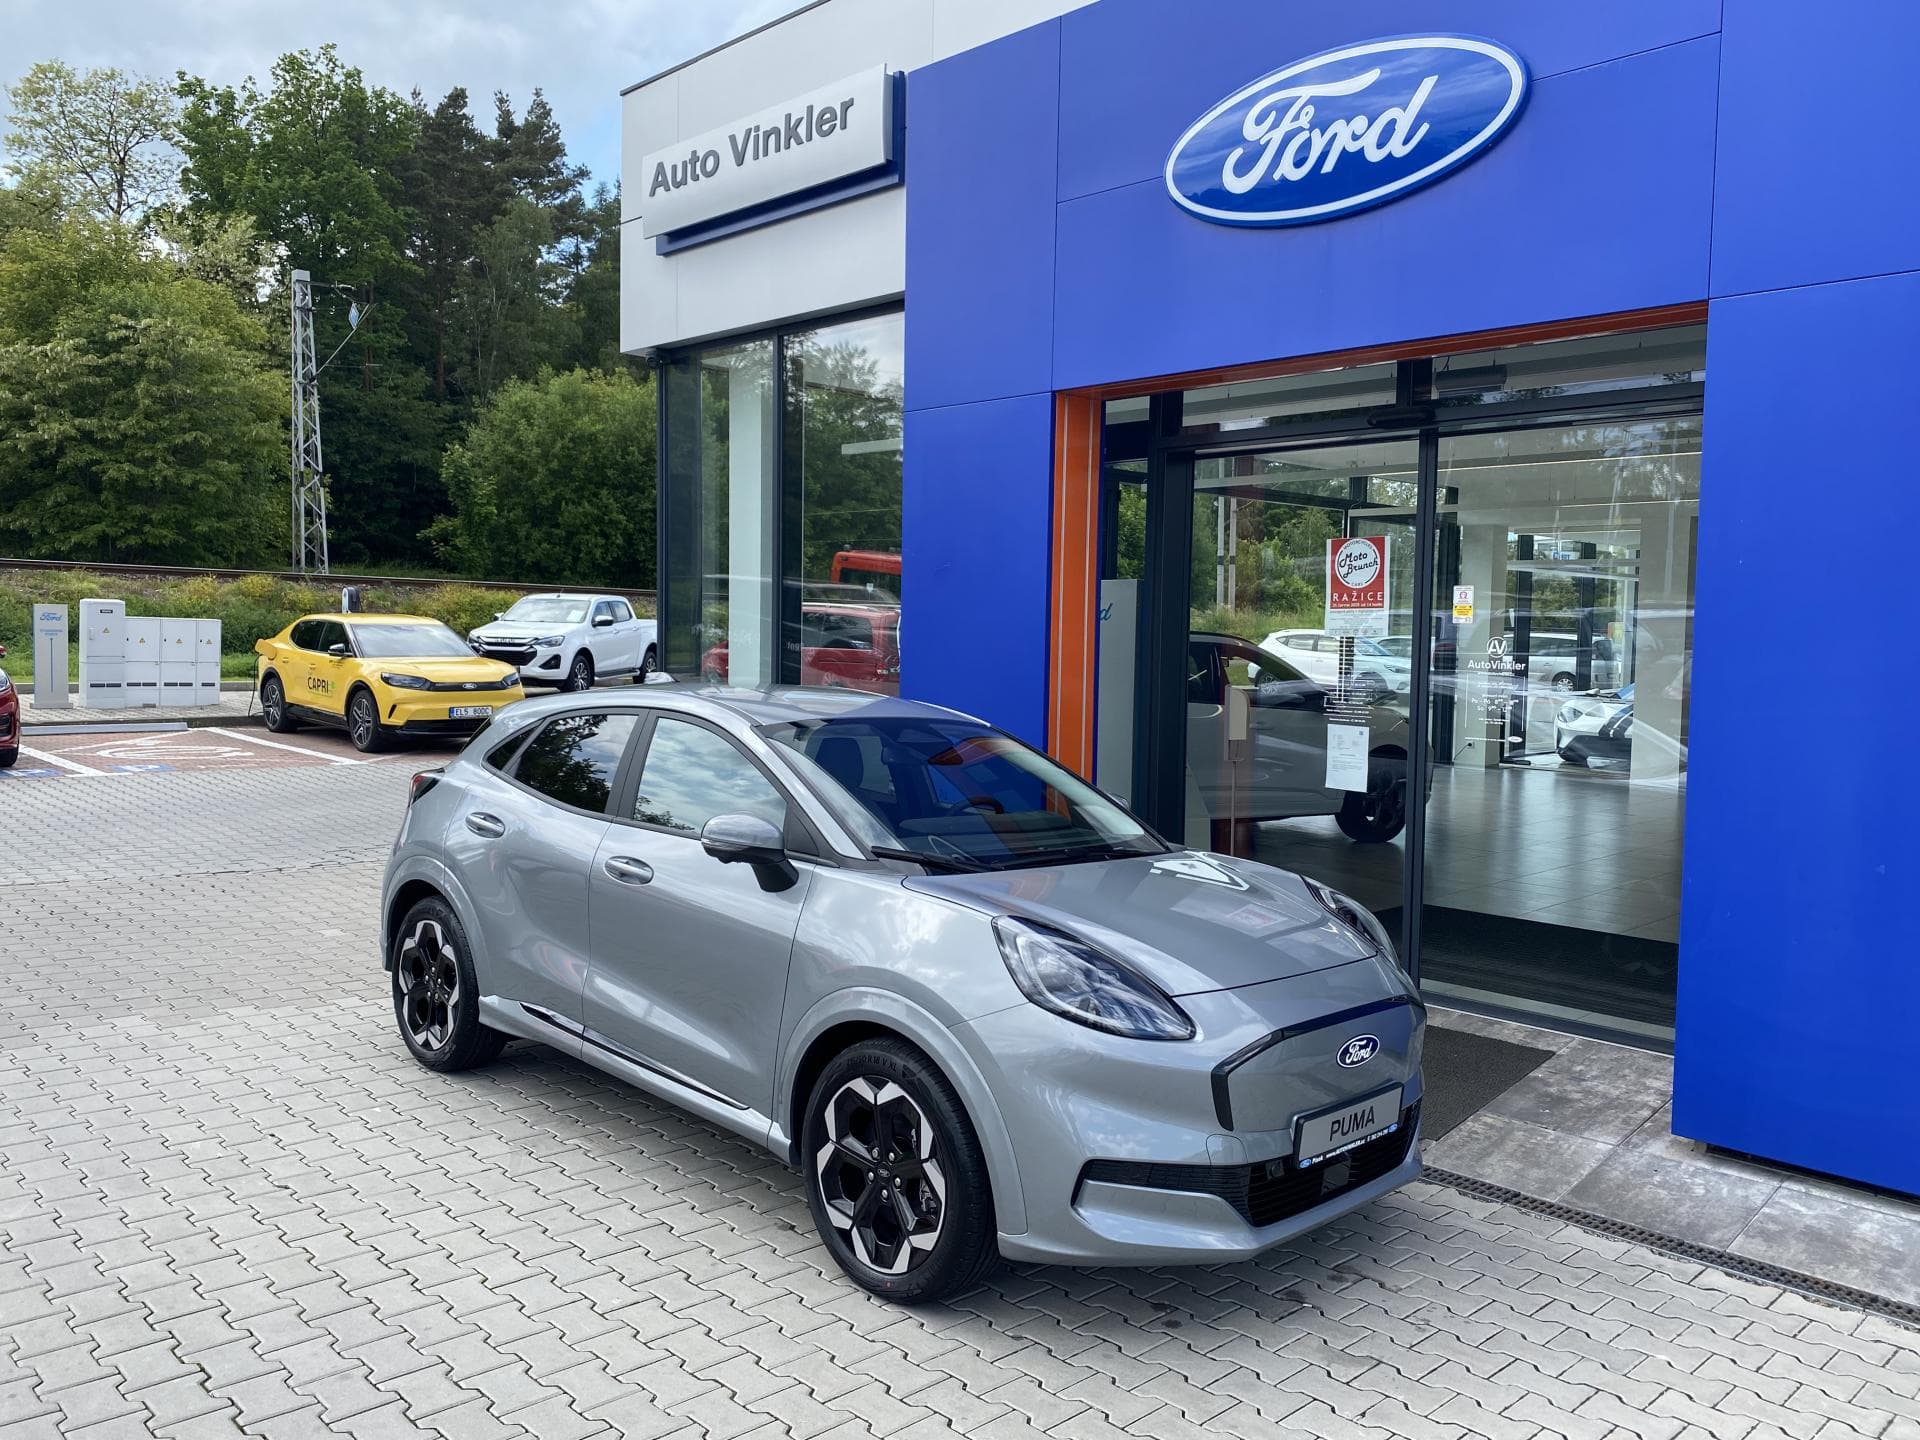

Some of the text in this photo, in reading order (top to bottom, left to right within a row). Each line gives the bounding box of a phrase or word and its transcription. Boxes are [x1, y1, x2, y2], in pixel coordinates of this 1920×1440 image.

[1222, 68, 1438, 194] Ford
[649, 97, 855, 197] Auto Vinkler
[1339, 551, 1368, 568] Moto
[1343, 557, 1380, 578] Brunch
[1332, 590, 1384, 602] RAŽICE
[40, 611, 63, 621] Ford
[1467, 659, 1527, 671] AutoVinkler
[307, 676, 329, 694] CAPRI
[1345, 1039, 1373, 1064] Ford
[1329, 1105, 1375, 1142] PUMA
